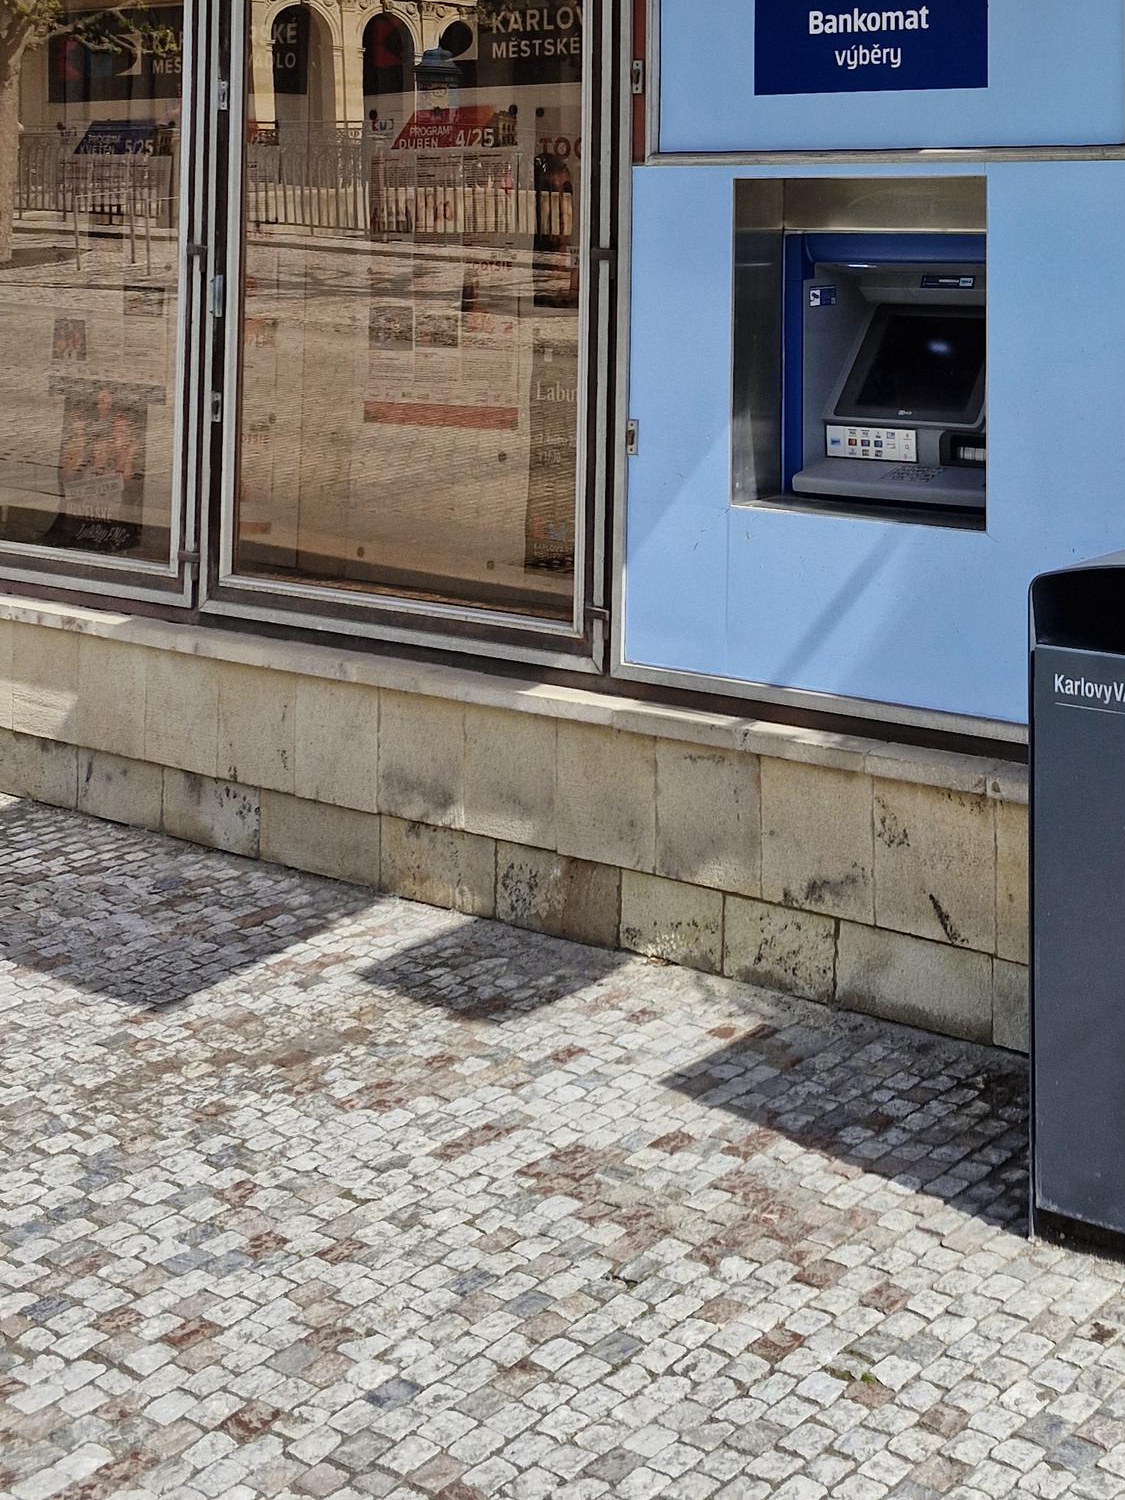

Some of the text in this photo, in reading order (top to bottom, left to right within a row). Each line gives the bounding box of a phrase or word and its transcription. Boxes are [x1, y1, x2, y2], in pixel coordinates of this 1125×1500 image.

[808, 6, 930, 35] Bankomat
[492, 33, 580, 60] MĚSTSKÉ
[834, 44, 902, 70] výběry
[409, 125, 450, 137] PROGRAM
[455, 128, 495, 148] 4/25
[399, 137, 438, 149] DUBEN
